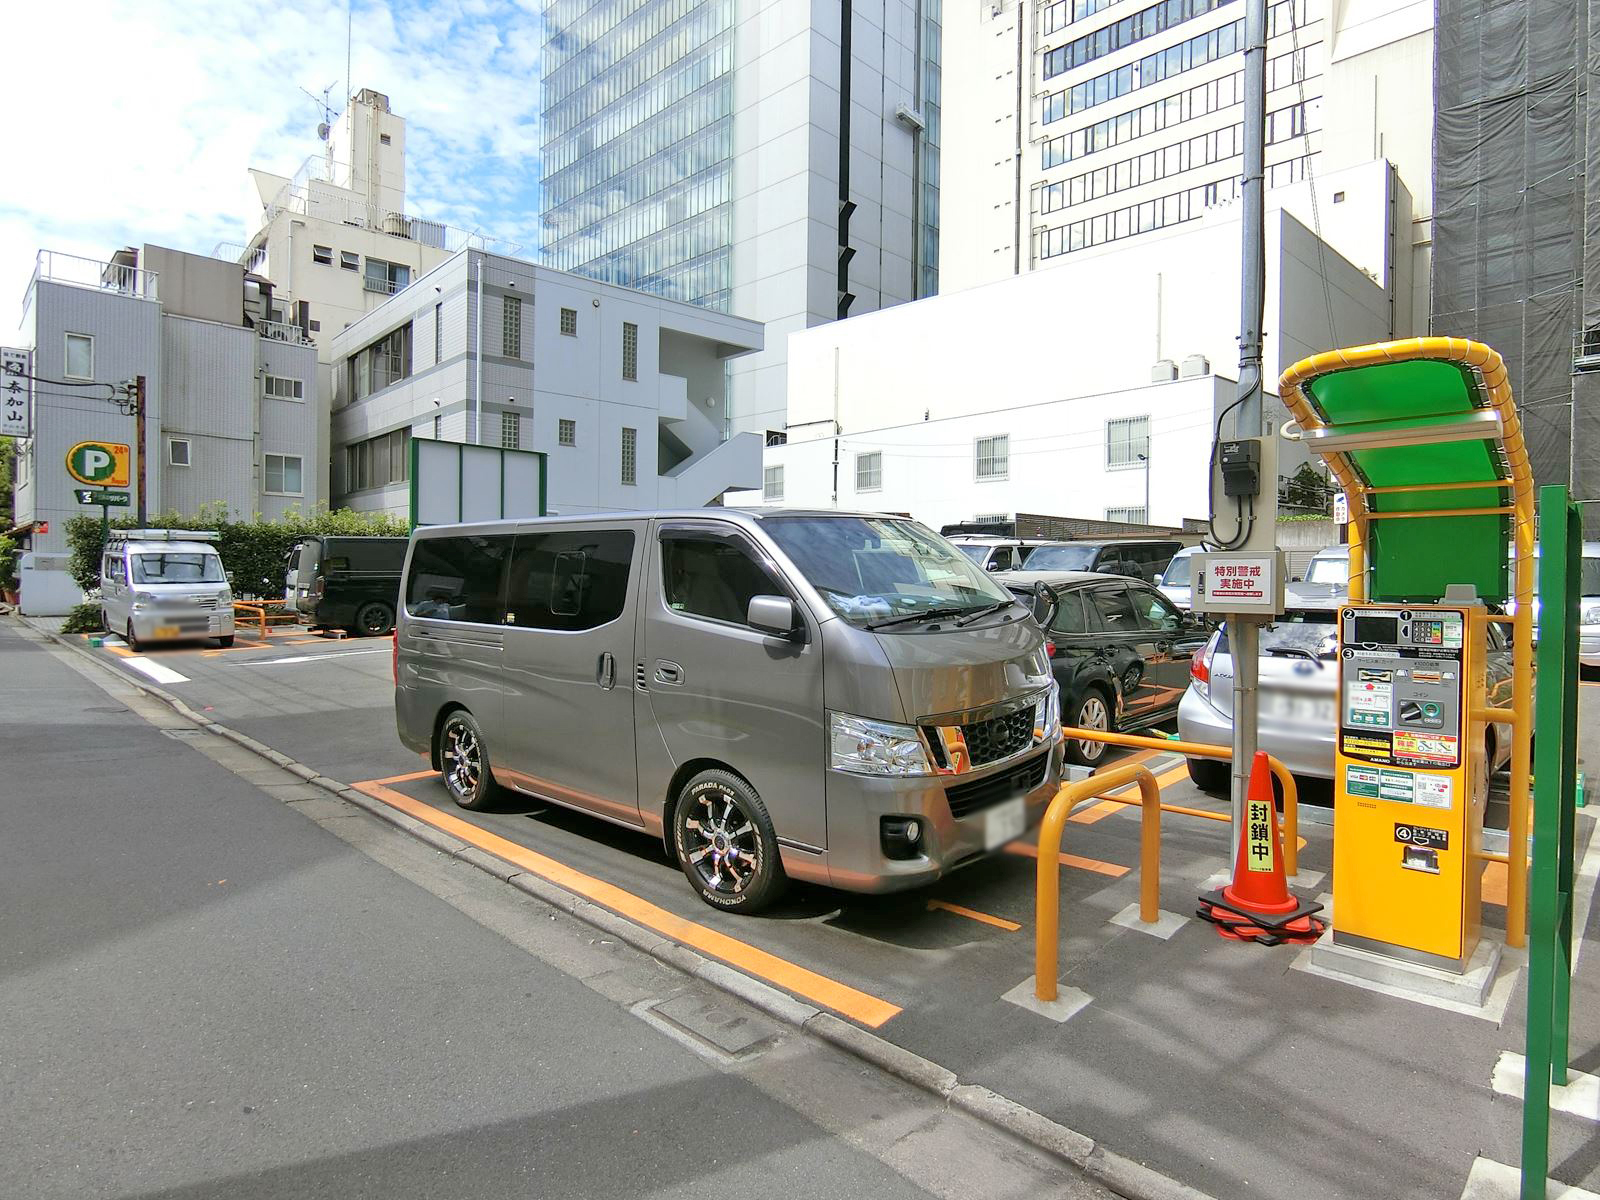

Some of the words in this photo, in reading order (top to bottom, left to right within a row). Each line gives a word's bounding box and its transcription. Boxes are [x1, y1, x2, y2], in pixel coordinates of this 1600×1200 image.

[85, 450, 110, 477] P
[1214, 565, 1262, 577] 特別警戒
[1220, 578, 1255, 590] 実施中
[691, 782, 718, 795] PARADA
[1250, 803, 1269, 861] 封鎖中
[702, 889, 746, 905] YOKOHAMA
